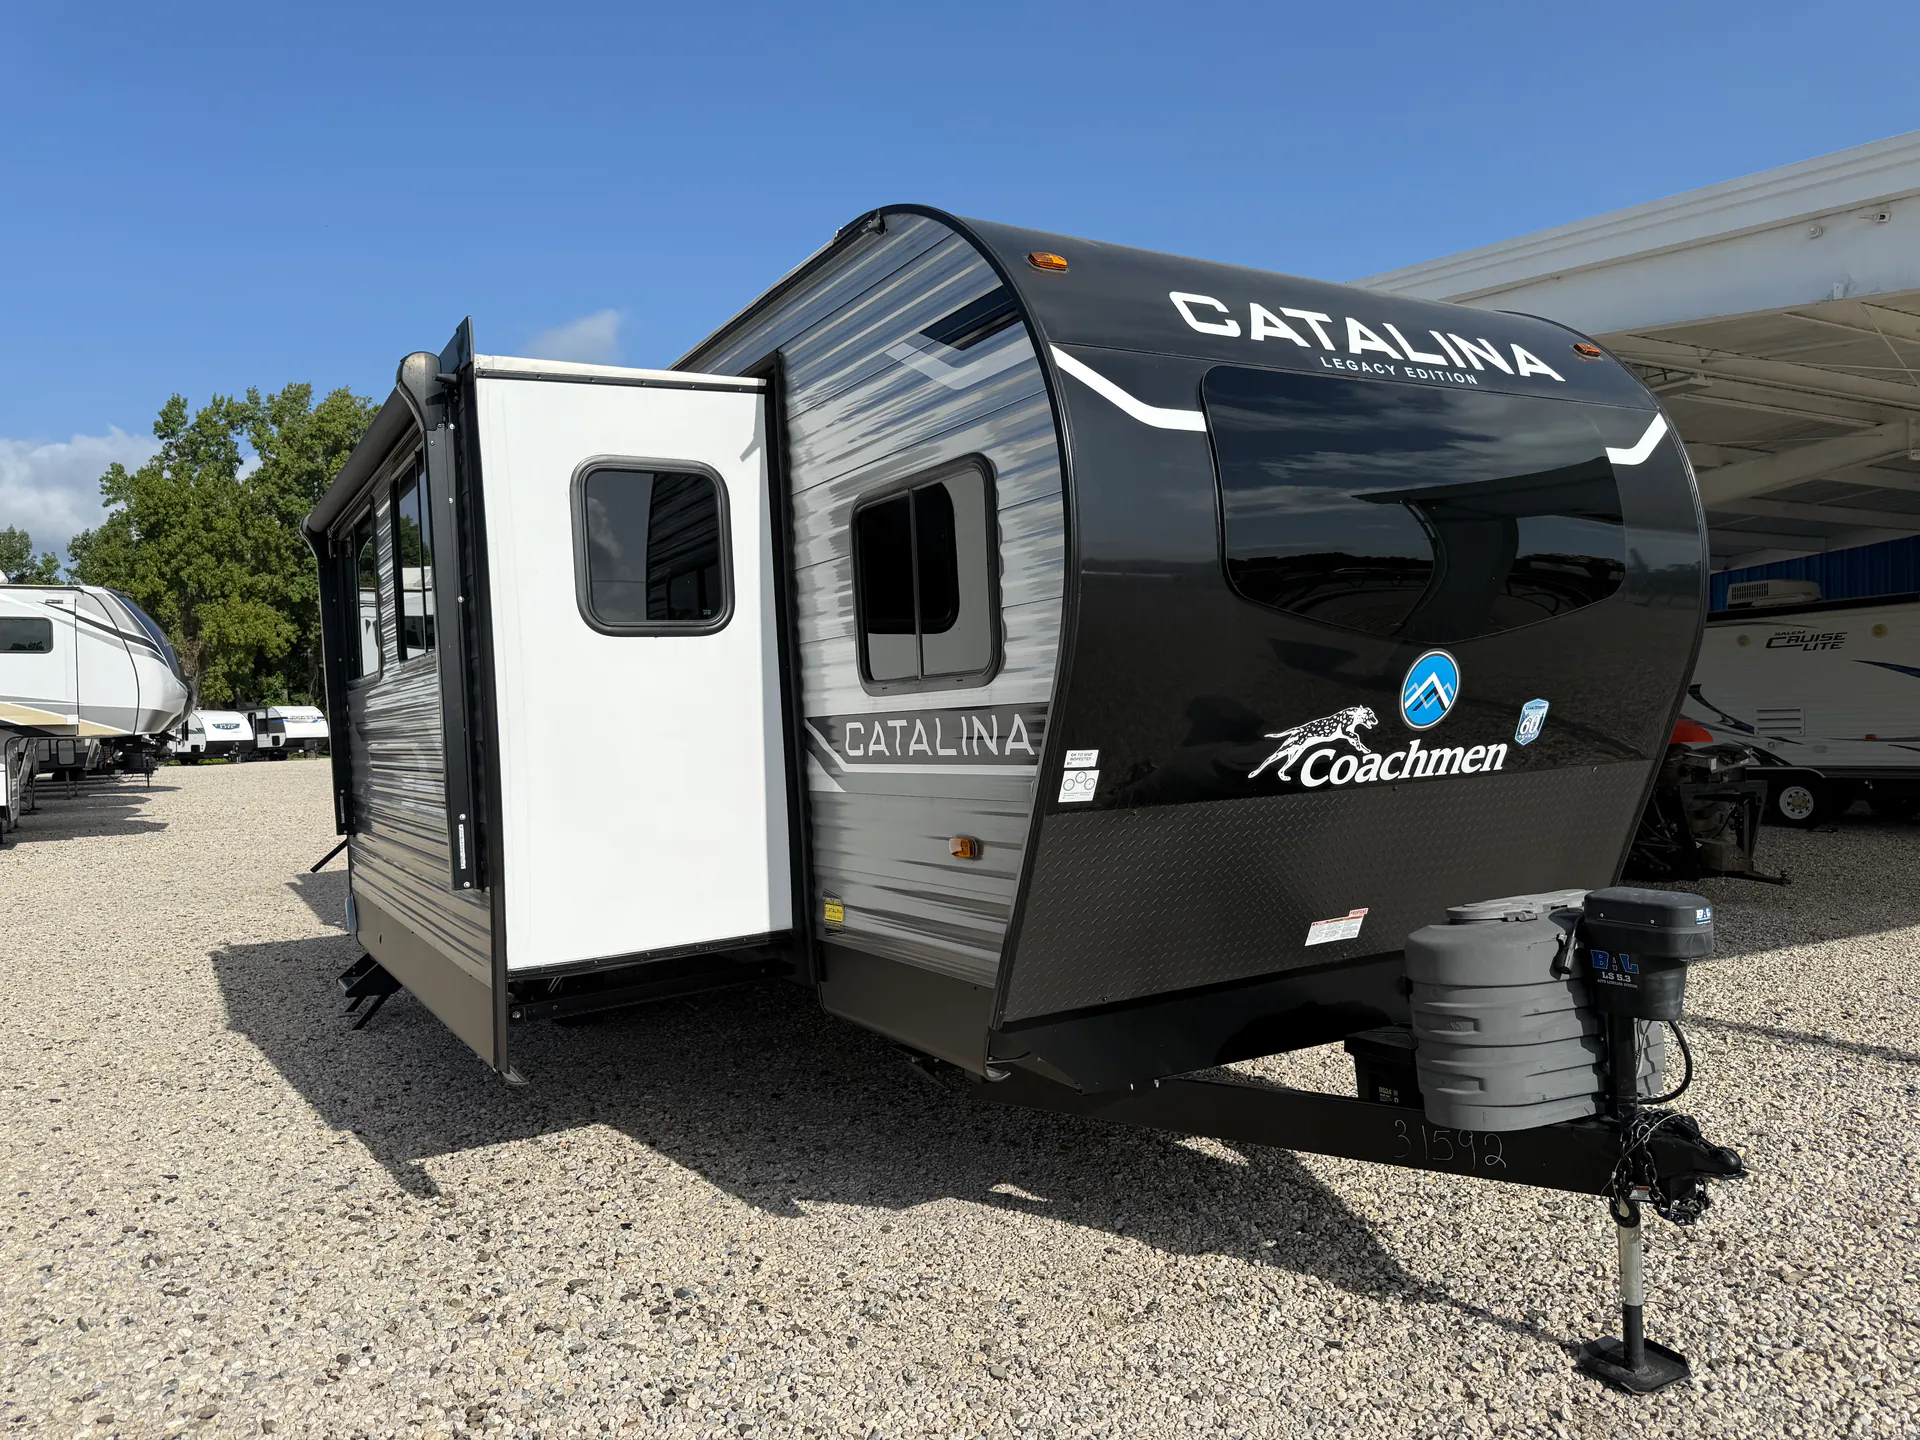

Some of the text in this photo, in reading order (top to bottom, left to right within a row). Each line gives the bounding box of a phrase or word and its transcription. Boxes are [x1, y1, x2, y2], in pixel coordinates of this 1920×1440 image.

[1169, 291, 1565, 381] CATALINA
[1320, 356, 1478, 384] LEGACY EDITION
[1802, 641, 1844, 651] LITE
[845, 713, 1036, 757] CATALINA
[1520, 714, 1541, 734] 60
[1300, 739, 1508, 787] Coachmen
[1602, 972, 1632, 983] LS 5.3
[1394, 1119, 1507, 1170] 31592
